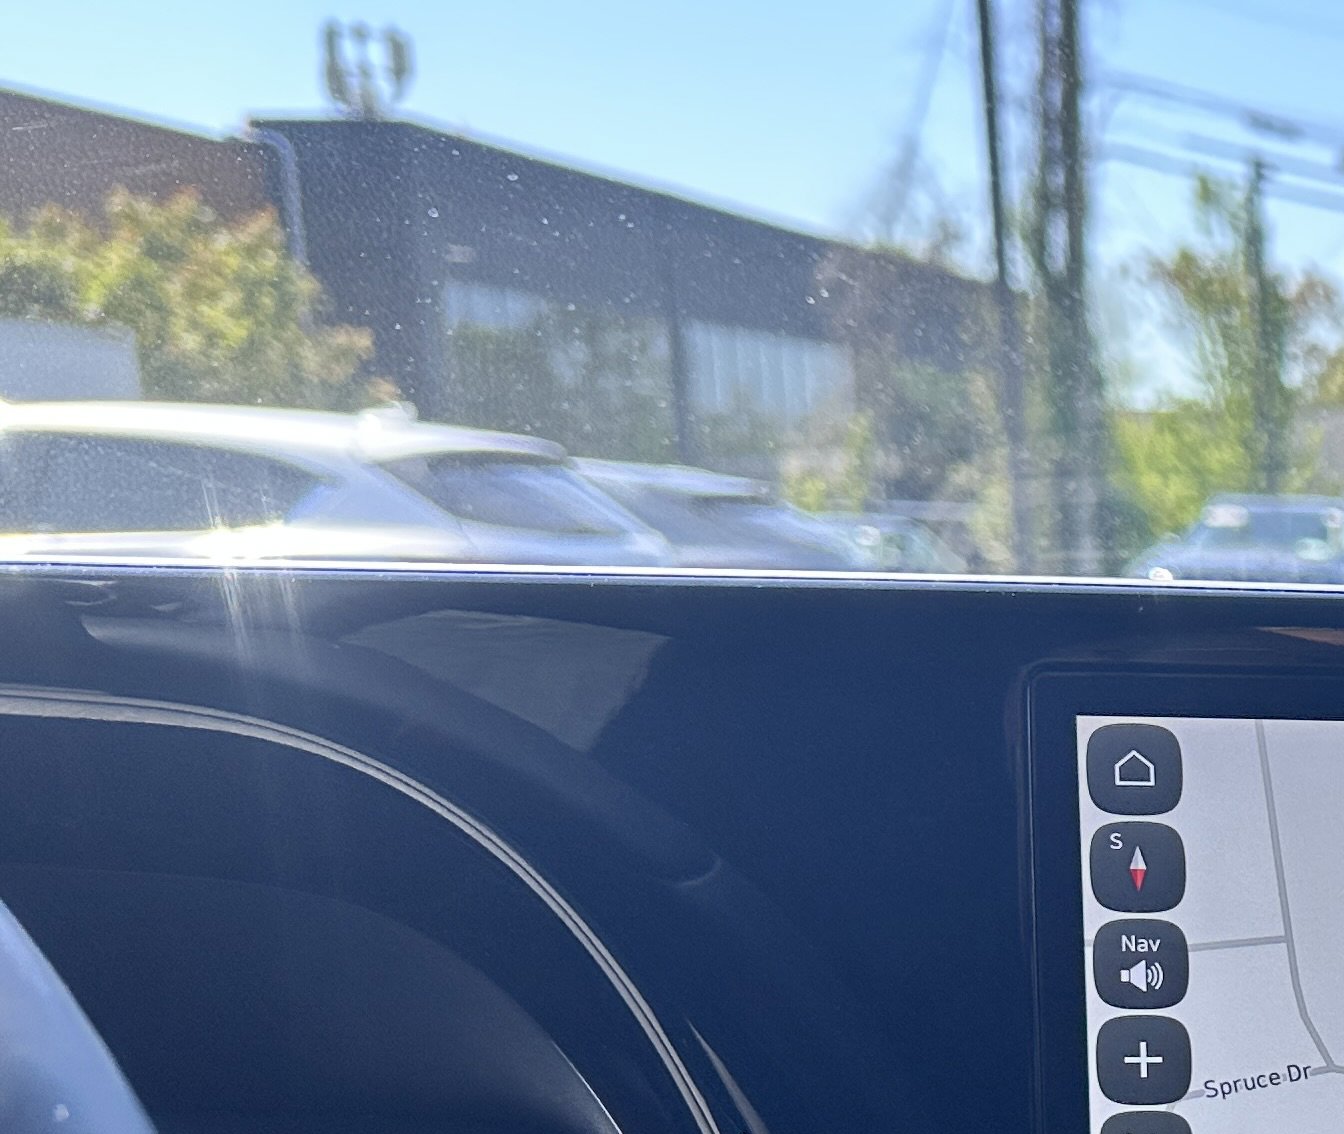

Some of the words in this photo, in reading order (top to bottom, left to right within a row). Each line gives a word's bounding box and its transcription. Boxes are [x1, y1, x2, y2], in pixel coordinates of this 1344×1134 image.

[1109, 832, 1123, 850] S
[1121, 934, 1161, 953] Nav
[1203, 1072, 1282, 1100] Spruce
[1286, 1064, 1312, 1083] Dr
